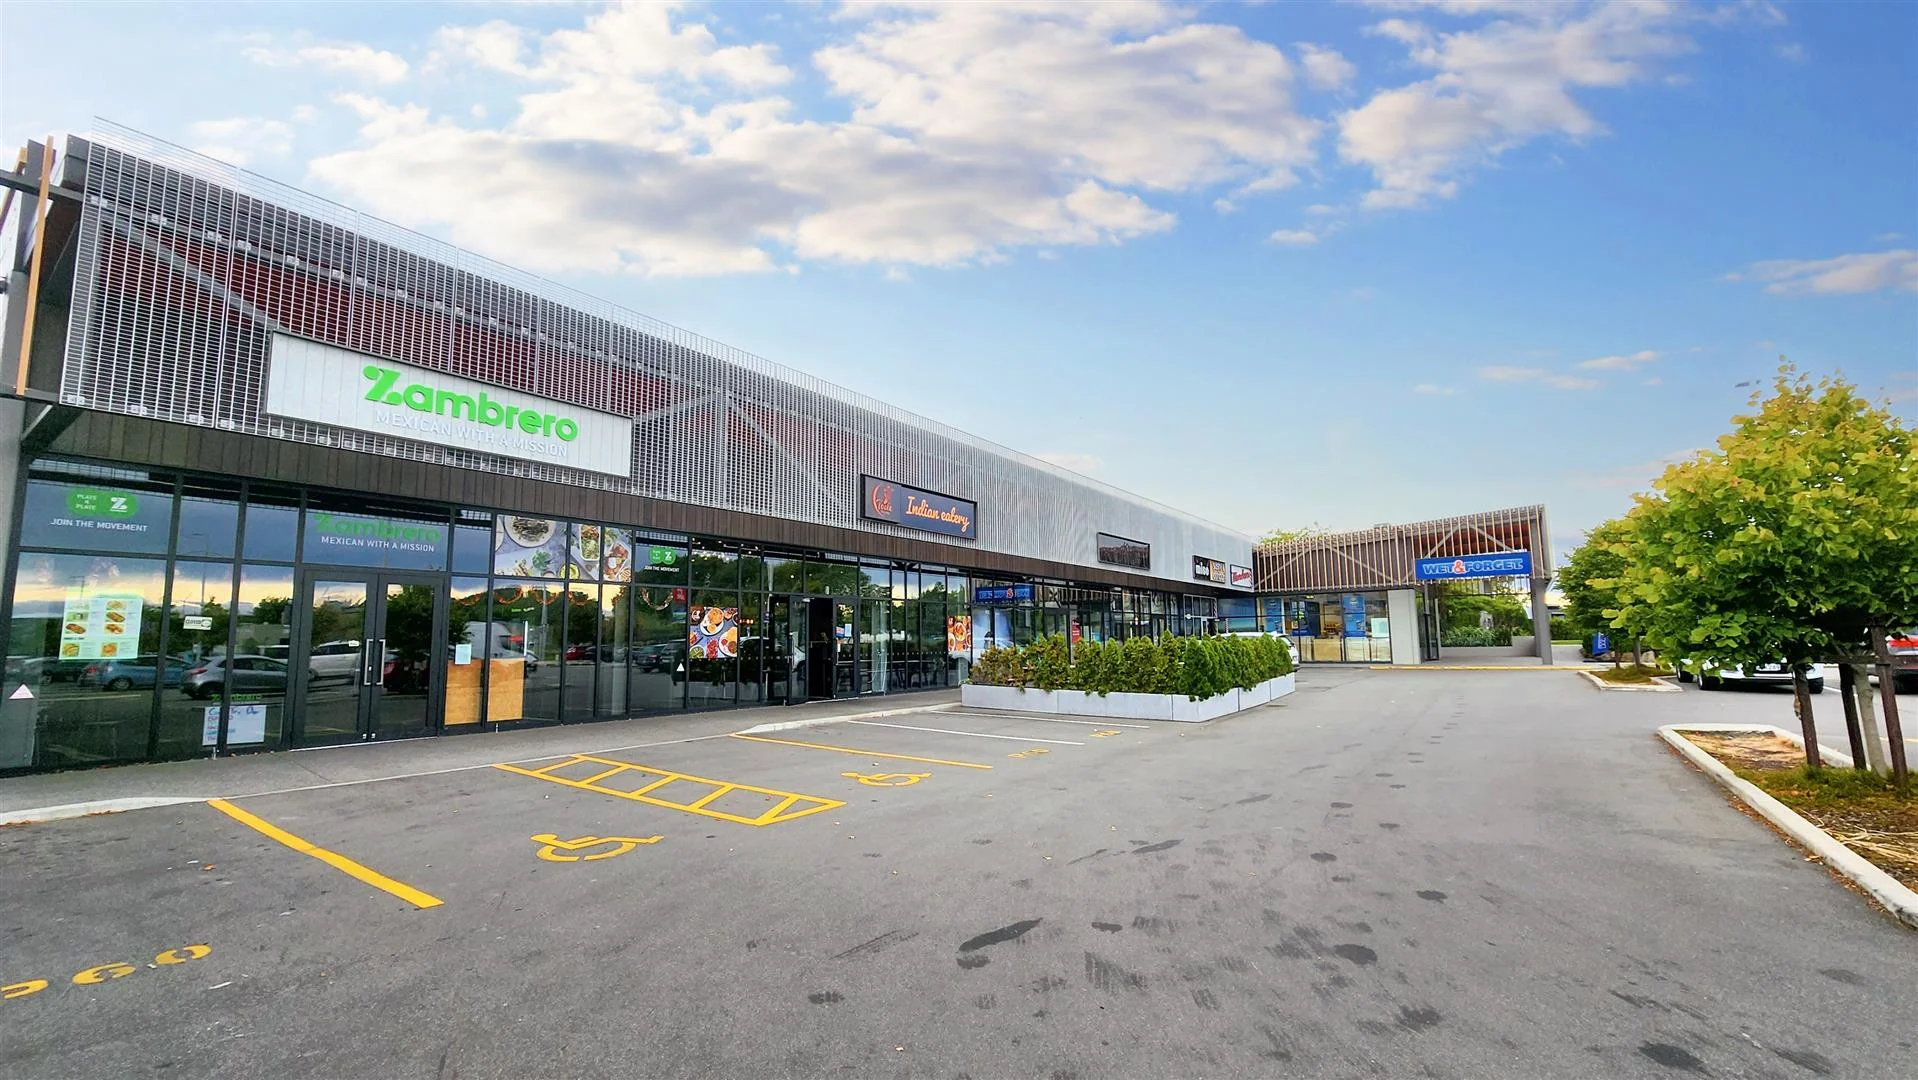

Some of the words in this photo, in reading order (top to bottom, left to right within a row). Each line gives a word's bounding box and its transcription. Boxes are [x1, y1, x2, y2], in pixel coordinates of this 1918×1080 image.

[362, 364, 578, 442] Zambrero
[375, 410, 451, 436] MEXICAN
[456, 426, 495, 444] WITH
[499, 436, 508, 447] A
[512, 438, 568, 458] MISSION
[50, 518, 73, 527] JOIN
[75, 519, 95, 528] THE
[96, 521, 148, 533] MOVEMENT
[906, 495, 940, 520] Indian
[940, 506, 970, 533] eatery
[321, 535, 364, 547] MEXICAN
[366, 540, 389, 549] WITH
[400, 542, 435, 553] MISSION
